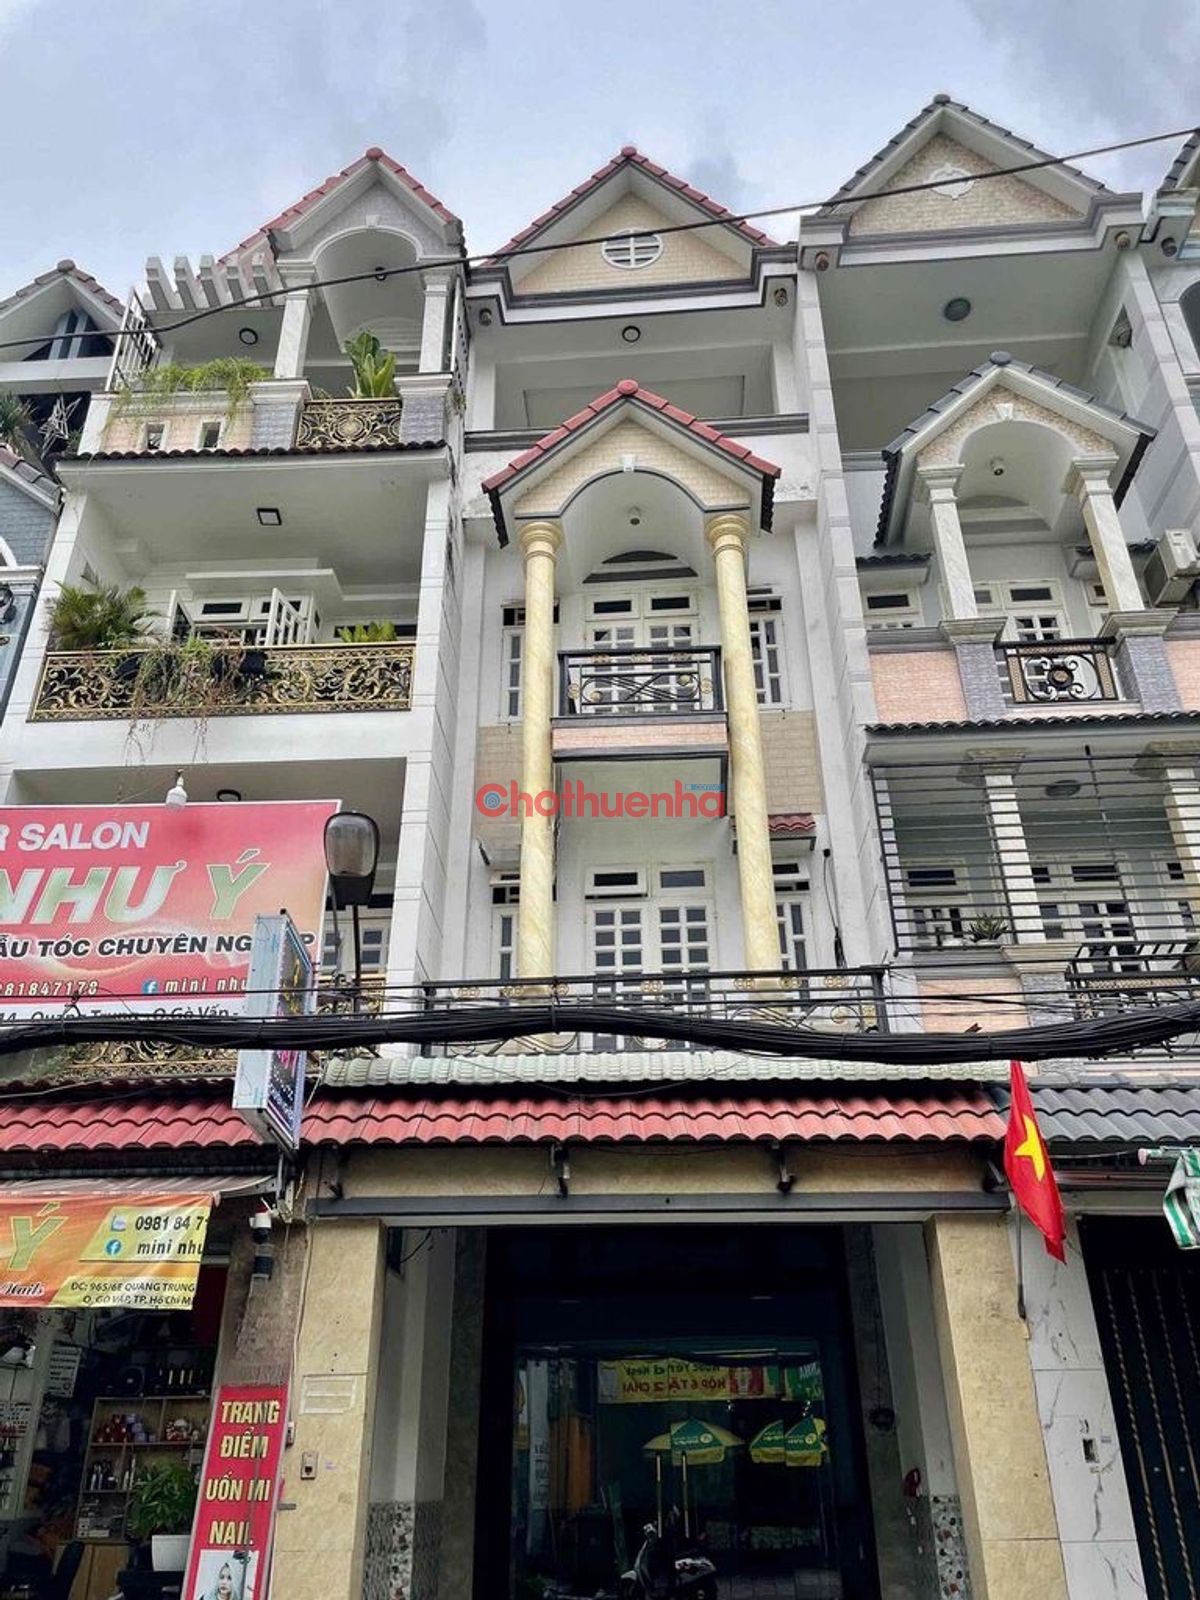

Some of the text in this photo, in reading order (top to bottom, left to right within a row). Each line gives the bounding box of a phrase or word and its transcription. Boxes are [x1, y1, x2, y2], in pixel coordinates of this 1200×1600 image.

[19, 822, 150, 850] SALON
[206, 848, 272, 920] Ý
[38, 933, 90, 957] TÓC
[99, 933, 207, 957] CHUYÊN
[0, 980, 99, 996] 81847178
[165, 977, 209, 993] mini
[135, 1215, 169, 1231] 0981
[173, 1215, 190, 1231] 84
[7, 1202, 69, 1271] Ý
[137, 1239, 172, 1255] mini
[124, 1282, 160, 1292] QUANG
[162, 1282, 195, 1292] TRUNG
[221, 1400, 280, 1424] TRANG
[219, 1426, 270, 1459] ĐIỂM
[205, 1471, 243, 1501] UỐN
